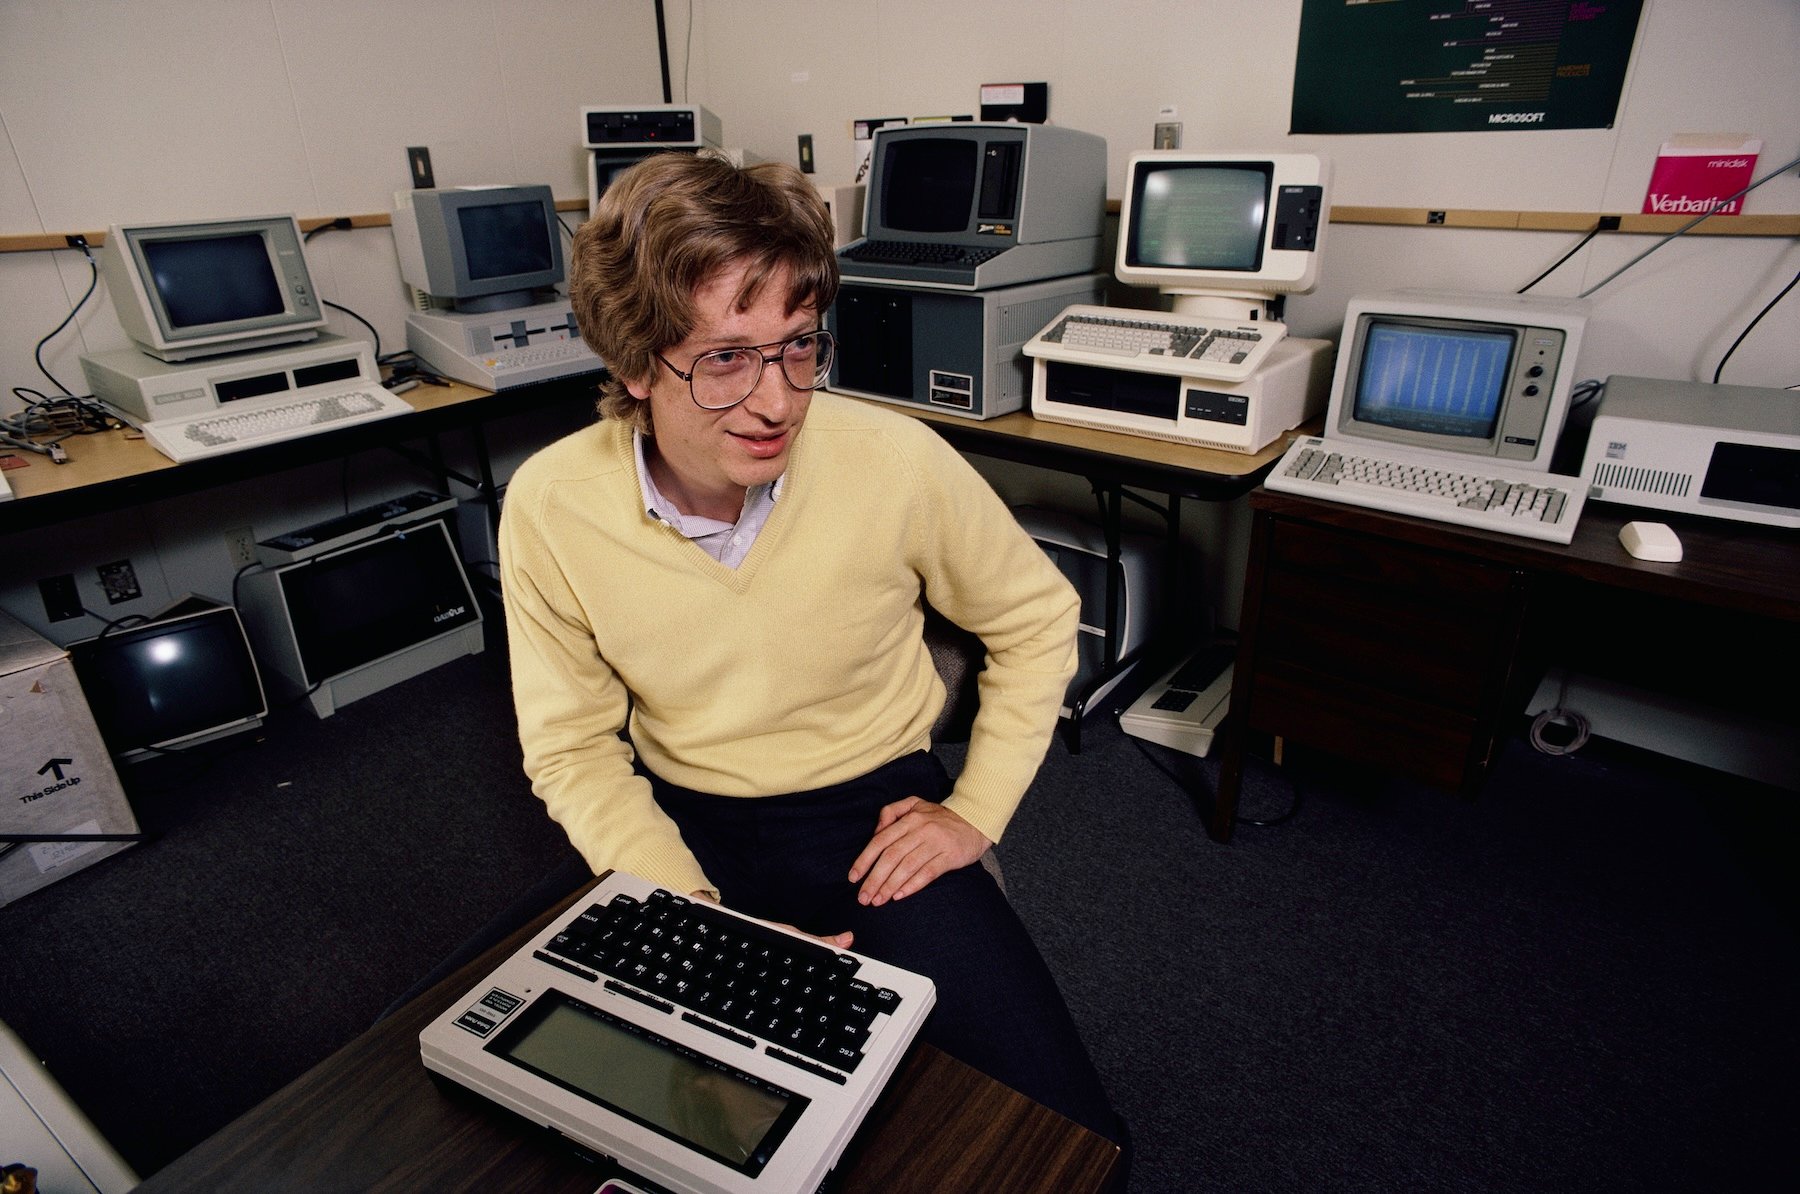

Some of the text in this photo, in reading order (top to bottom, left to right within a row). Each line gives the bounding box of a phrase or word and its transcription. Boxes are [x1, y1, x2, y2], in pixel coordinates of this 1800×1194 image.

[1488, 112, 1546, 124] MICROSOFT
[1707, 158, 1748, 168] minidisk
[1650, 193, 1736, 213] Verbatim
[20, 777, 80, 804] This Side Up
[581, 914, 598, 922] ENTER
[850, 982, 868, 991] SHIFT
[852, 1004, 866, 1013] CTRL
[845, 1025, 856, 1033] TAB
[839, 1048, 854, 1057] ESC
